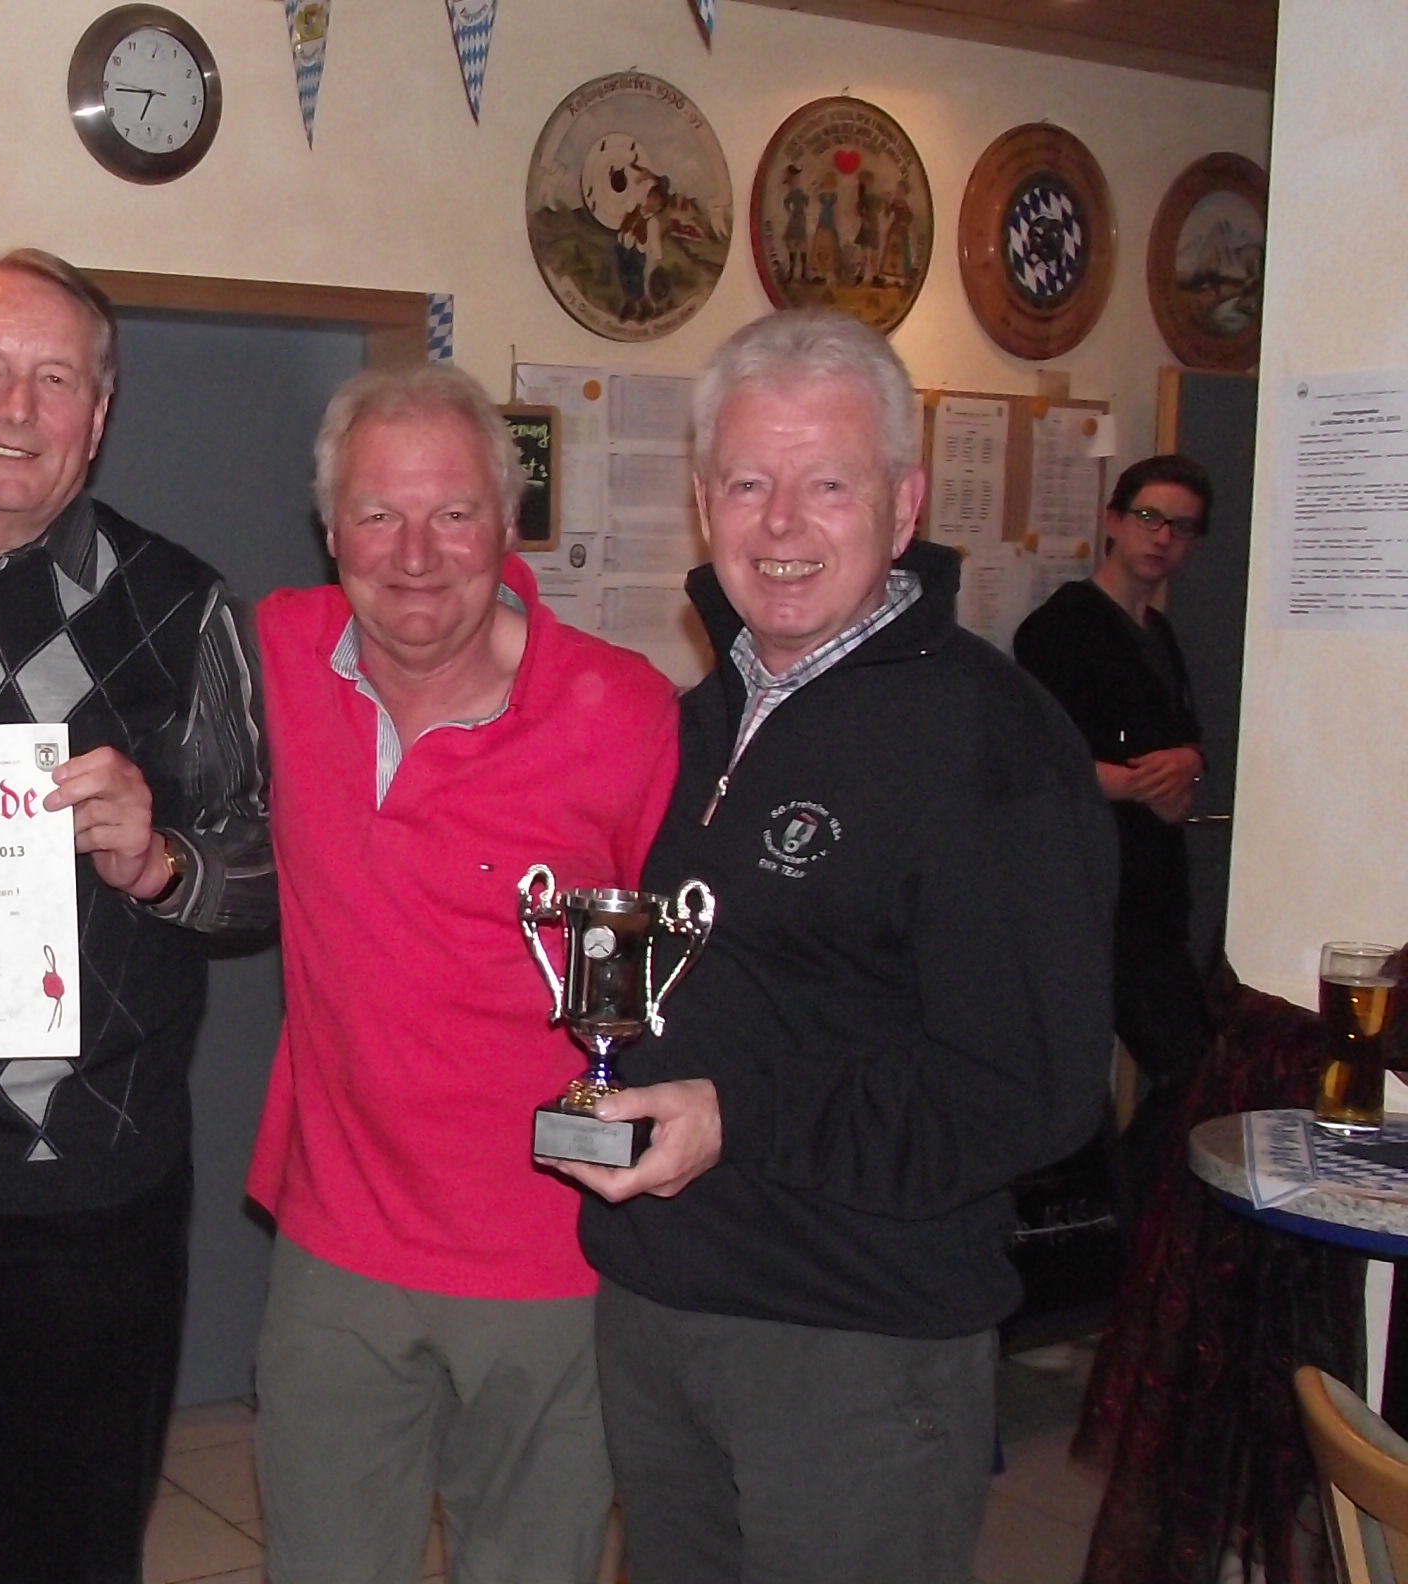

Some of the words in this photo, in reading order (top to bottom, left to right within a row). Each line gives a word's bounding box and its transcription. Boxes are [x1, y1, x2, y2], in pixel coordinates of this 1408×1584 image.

[128, 41, 137, 51] 11
[186, 69, 192, 79] 2
[124, 127, 130, 137] 7
